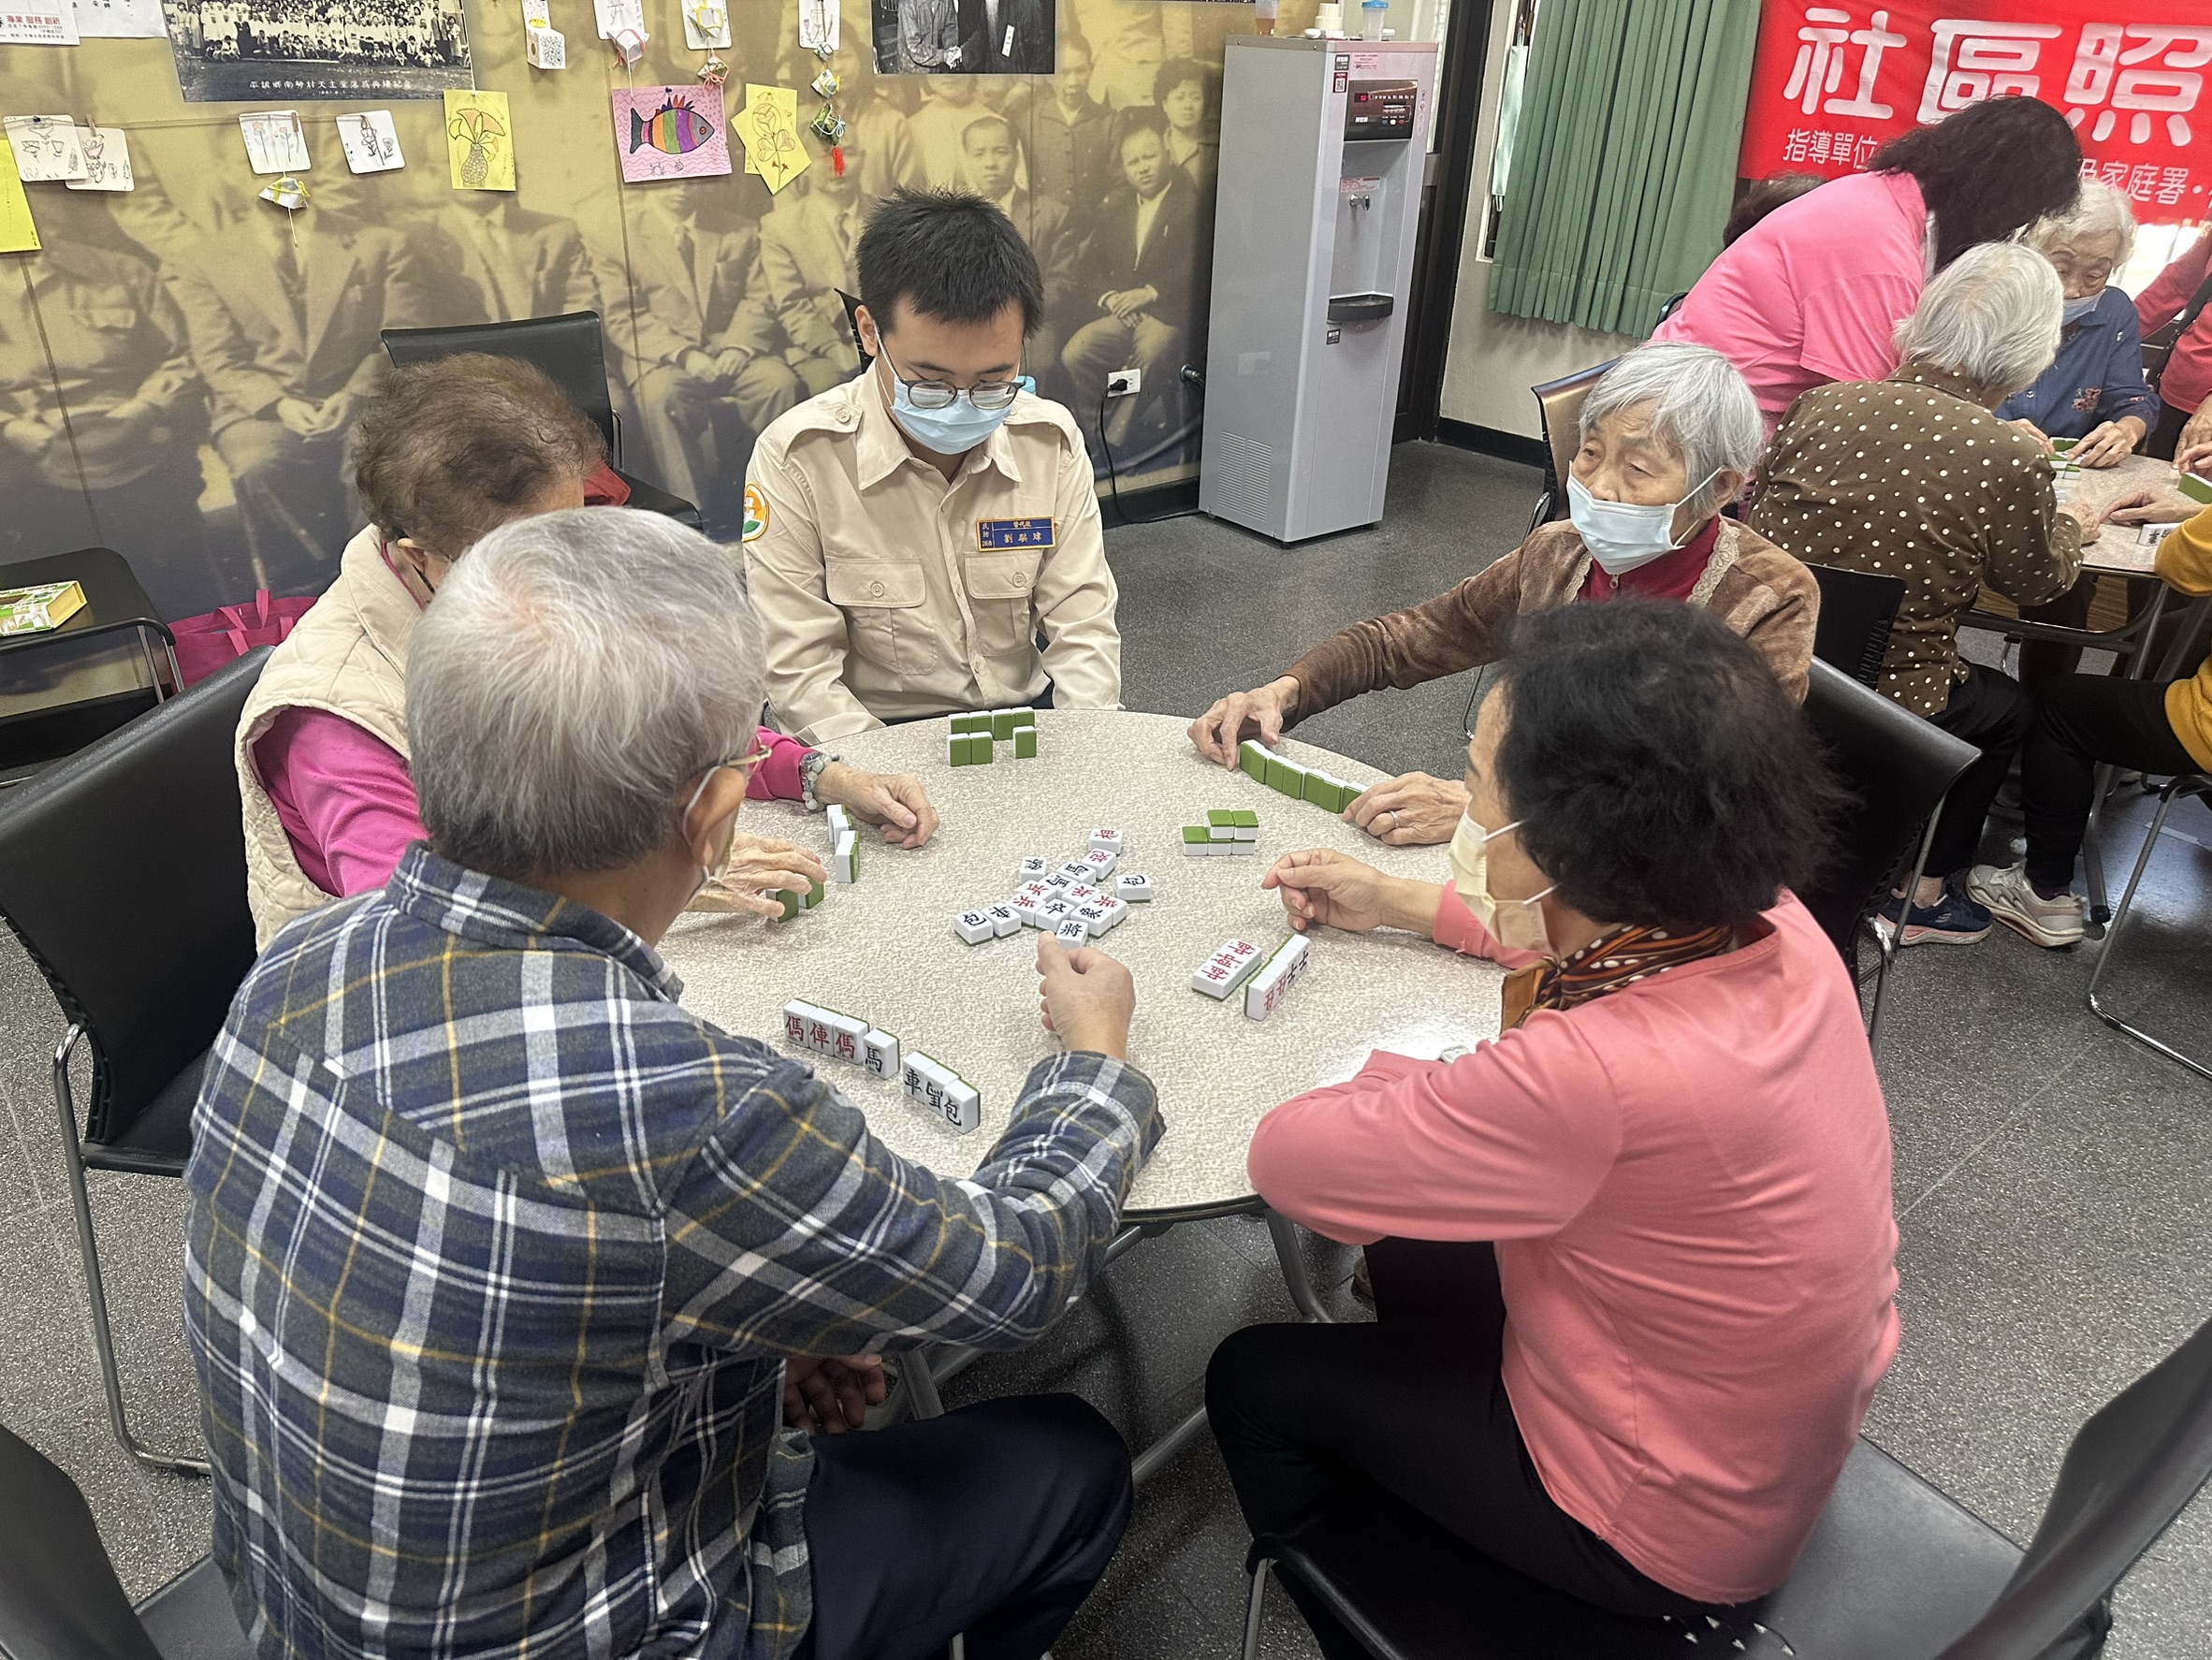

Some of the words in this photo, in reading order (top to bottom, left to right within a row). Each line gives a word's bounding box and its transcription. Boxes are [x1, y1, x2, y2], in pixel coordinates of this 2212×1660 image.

[1783, 7, 2212, 147] 社區照
[1783, 128, 1878, 168] 指導單位
[1064, 863, 1089, 876] 馬
[1045, 875, 1071, 888] 馬
[1122, 874, 1147, 886] 包
[1028, 883, 1050, 896] 兵
[1071, 885, 1096, 897] 兵
[1012, 895, 1037, 908] 兵
[1044, 902, 1068, 915] 卒
[1093, 895, 1119, 908] 兵
[963, 912, 987, 927] 包
[1060, 923, 1084, 938] 將
[785, 1015, 805, 1042] 傌
[809, 1022, 830, 1049] 俥
[836, 1031, 855, 1060] 傌
[865, 1044, 883, 1073] 馬
[904, 1068, 923, 1096] 車
[943, 1096, 962, 1127] 包
